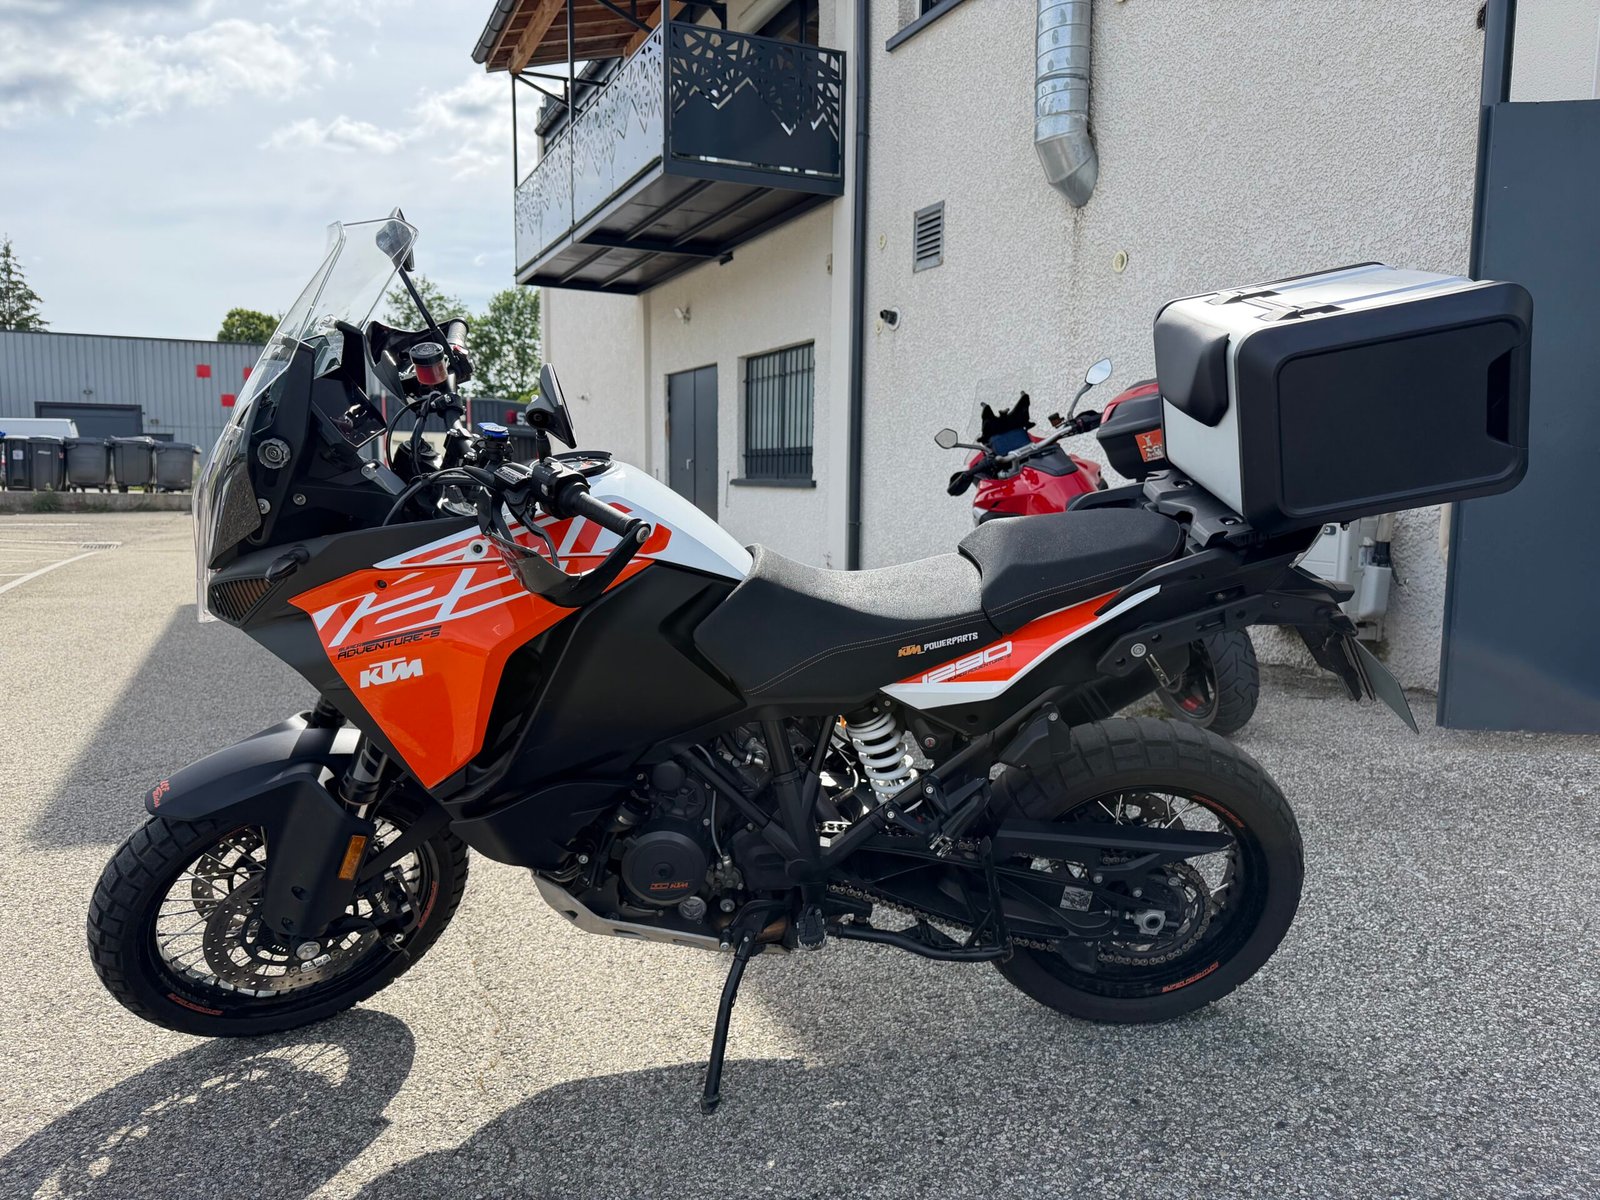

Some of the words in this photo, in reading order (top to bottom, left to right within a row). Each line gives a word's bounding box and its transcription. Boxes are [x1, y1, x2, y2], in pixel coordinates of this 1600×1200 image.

[337, 628, 441, 660] ADVENTURE-S
[359, 656, 424, 689] KTM
[921, 640, 1013, 685] 1290
